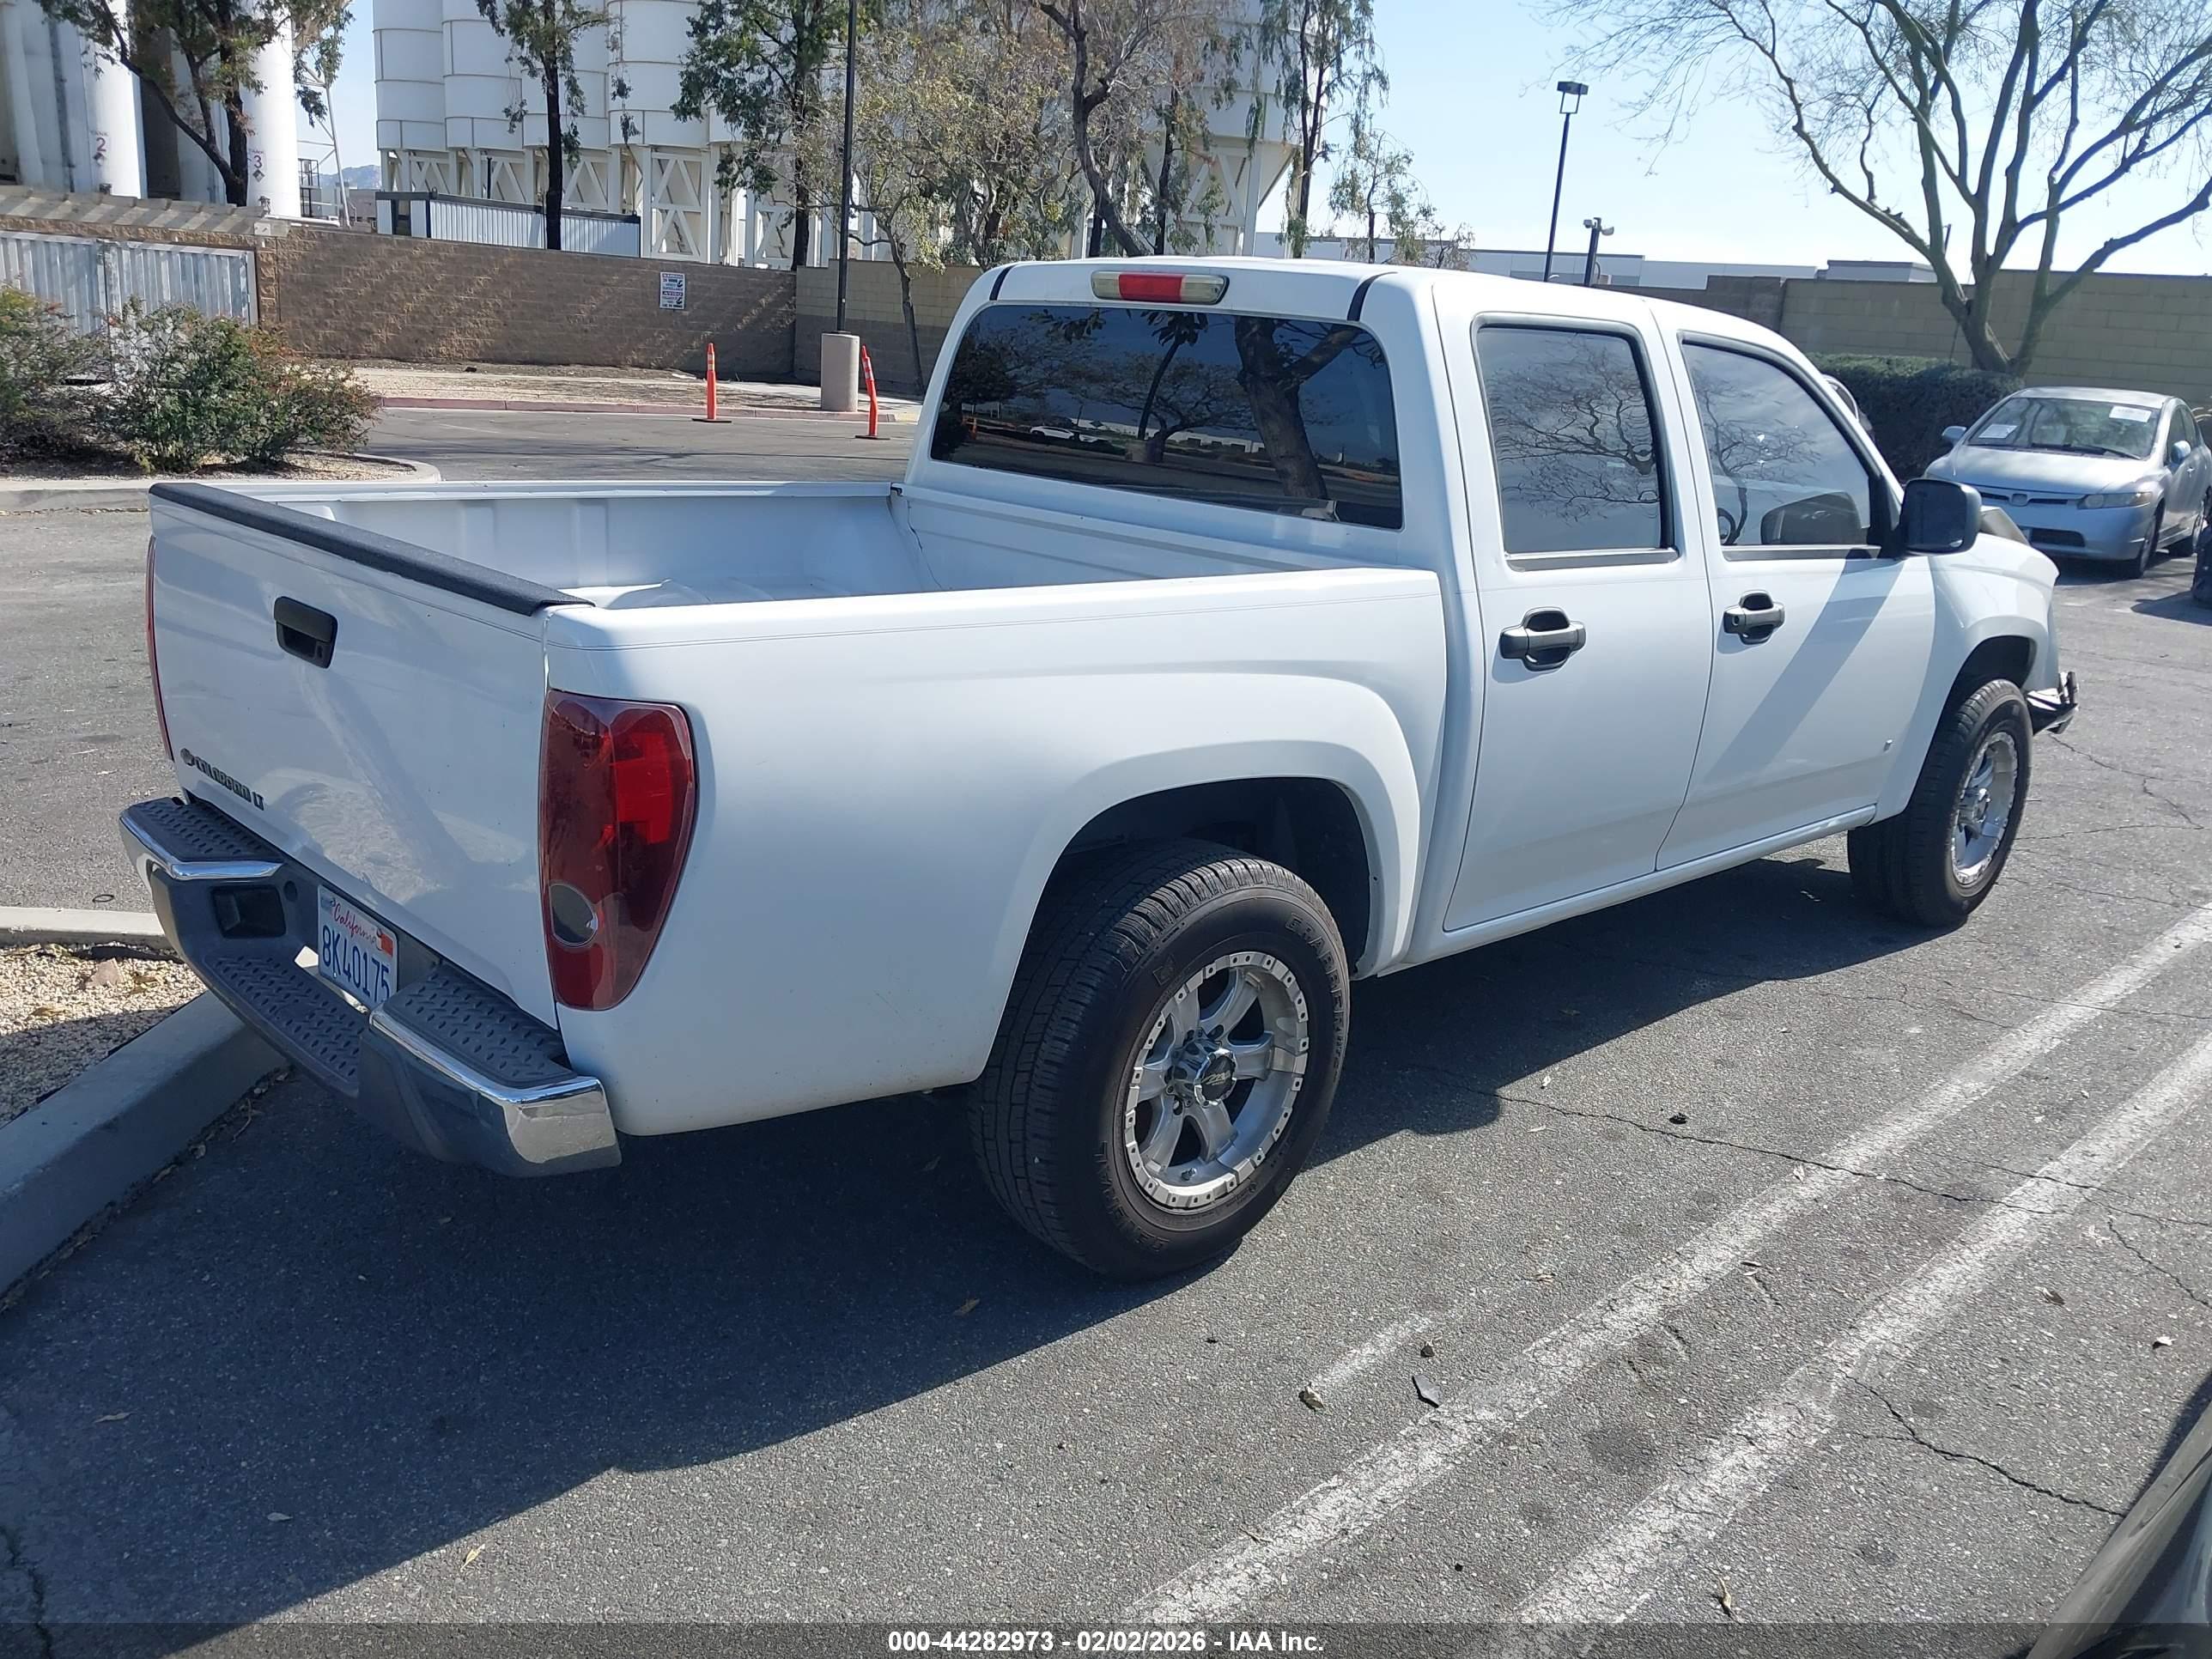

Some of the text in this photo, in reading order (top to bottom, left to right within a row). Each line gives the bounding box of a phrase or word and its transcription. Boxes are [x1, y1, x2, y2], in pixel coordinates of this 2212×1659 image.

[96, 137, 106, 151] 2
[254, 155, 262, 168] 3
[252, 791, 264, 811] LT
[333, 902, 378, 944] California
[322, 925, 391, 1003] 8K40175
